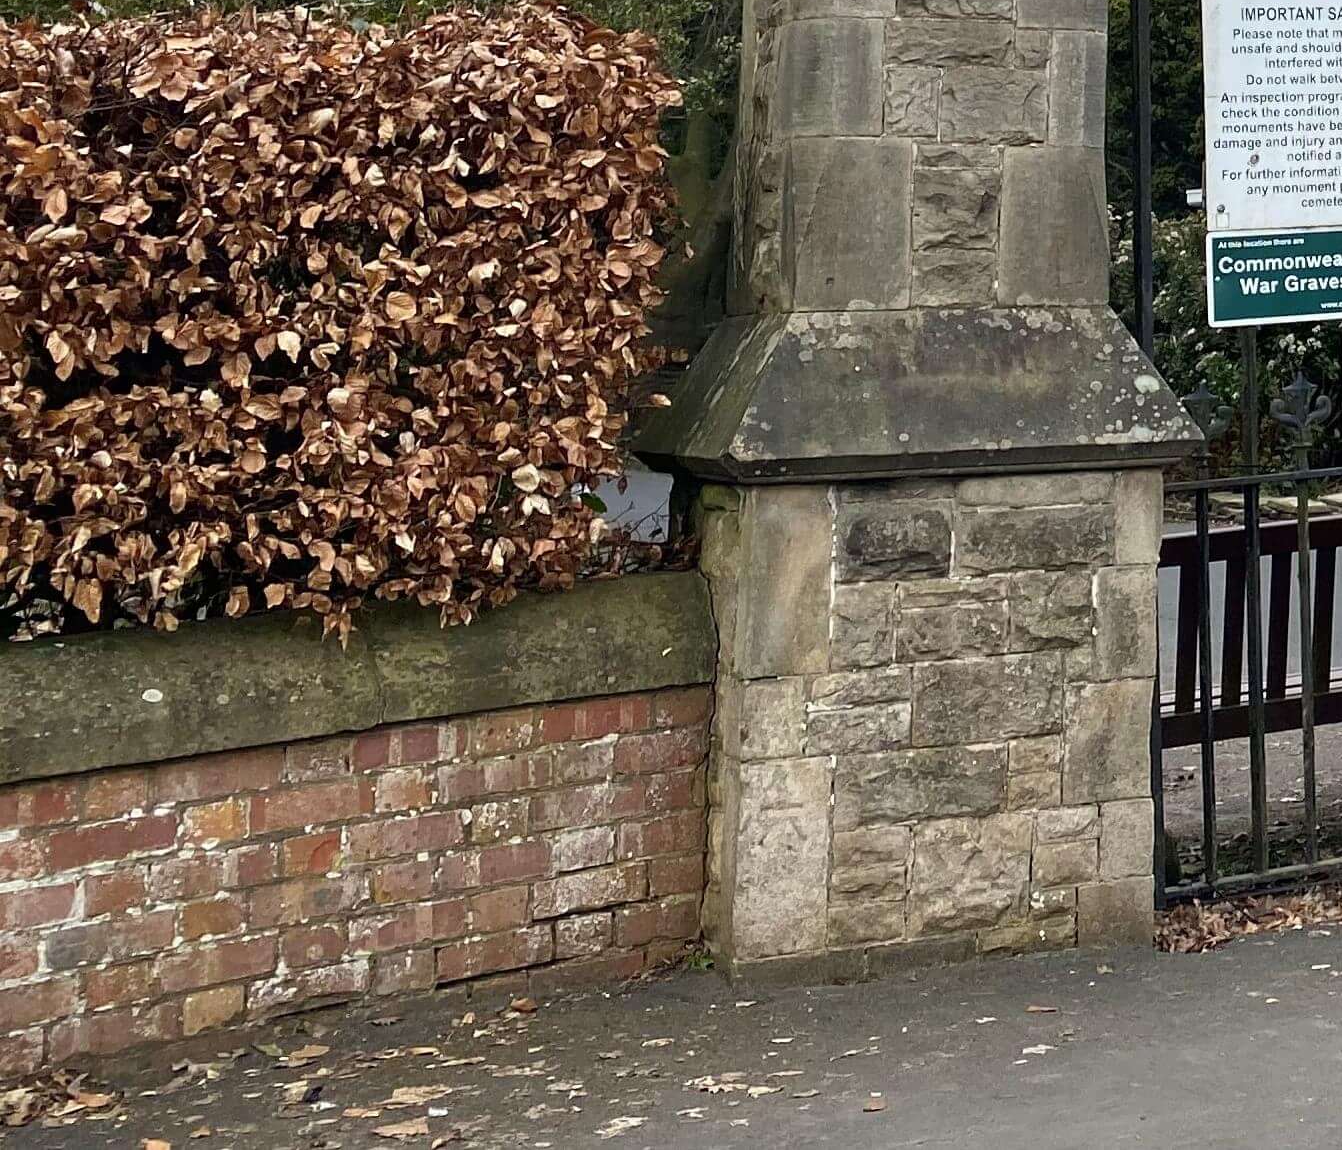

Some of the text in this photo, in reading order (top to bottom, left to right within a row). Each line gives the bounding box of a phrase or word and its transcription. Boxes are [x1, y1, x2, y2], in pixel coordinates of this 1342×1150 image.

[1241, 8, 1323, 21] IMPORTANT
[1233, 29, 1272, 38] Please
[1277, 29, 1302, 38] note
[1306, 28, 1328, 38] that
[1232, 44, 1272, 54] unsafe
[1276, 43, 1297, 53] and
[1302, 43, 1341, 52] should
[1265, 58, 1322, 68] interfered
[1246, 75, 1262, 85] Do
[1266, 74, 1286, 84] not
[1290, 74, 1316, 84] walk
[1221, 93, 1237, 103] An
[1242, 92, 1303, 105] inspection
[1222, 107, 1257, 118] check
[1262, 107, 1279, 117] the
[1284, 106, 1339, 116] condition
[1222, 122, 1293, 132] monuments
[1298, 121, 1325, 131] have
[1214, 138, 1261, 150] damage
[1266, 137, 1287, 147] and
[1291, 136, 1325, 148] injury
[1287, 151, 1331, 161] notified
[1222, 170, 1241, 180] For
[1246, 168, 1286, 179] further
[1247, 185, 1268, 196] any
[1273, 182, 1335, 193] monument
[1240, 278, 1279, 295] War
